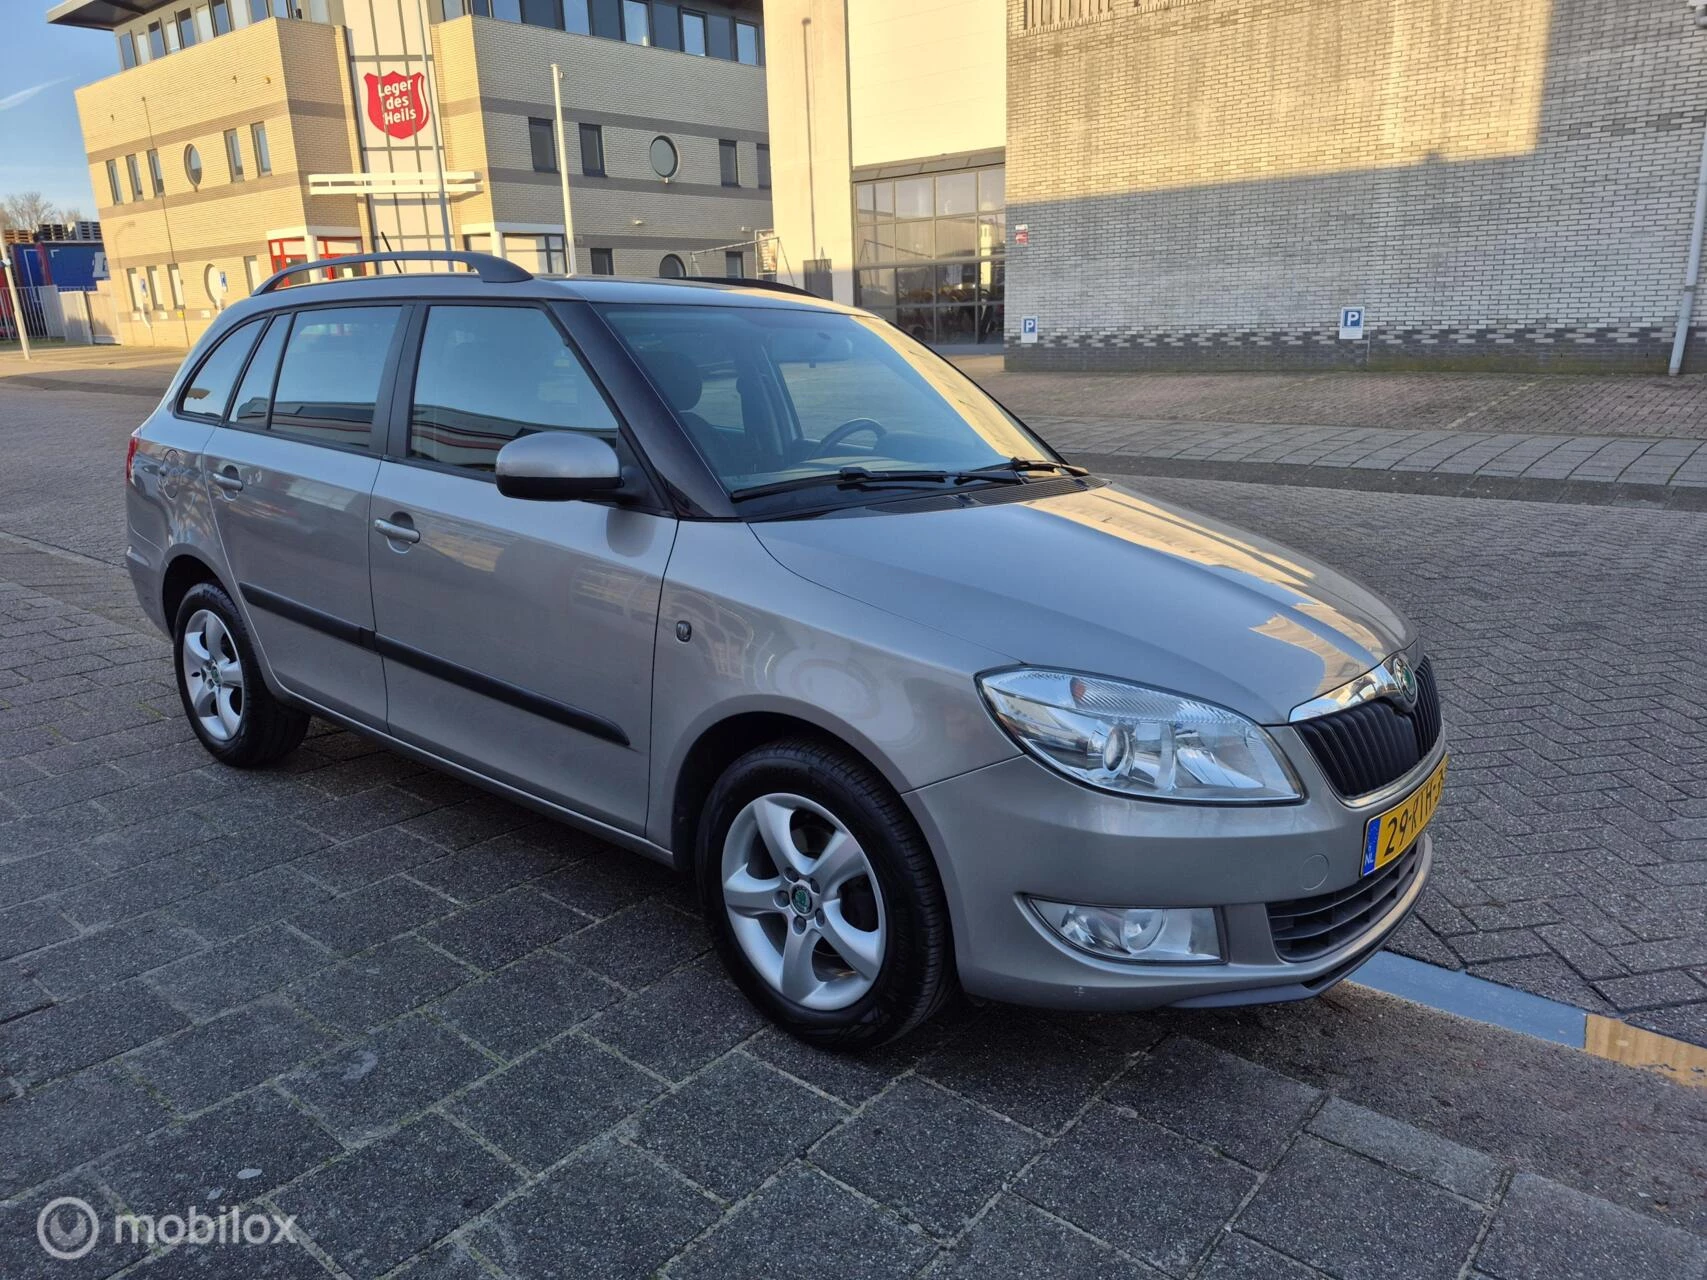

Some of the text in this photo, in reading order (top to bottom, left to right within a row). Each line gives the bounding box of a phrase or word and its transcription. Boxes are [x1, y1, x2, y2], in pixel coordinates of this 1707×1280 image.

[378, 79, 413, 97] Leger
[386, 96, 409, 110] des
[384, 108, 416, 125] Heils
[1347, 312, 1359, 325] P
[1026, 320, 1034, 332] P
